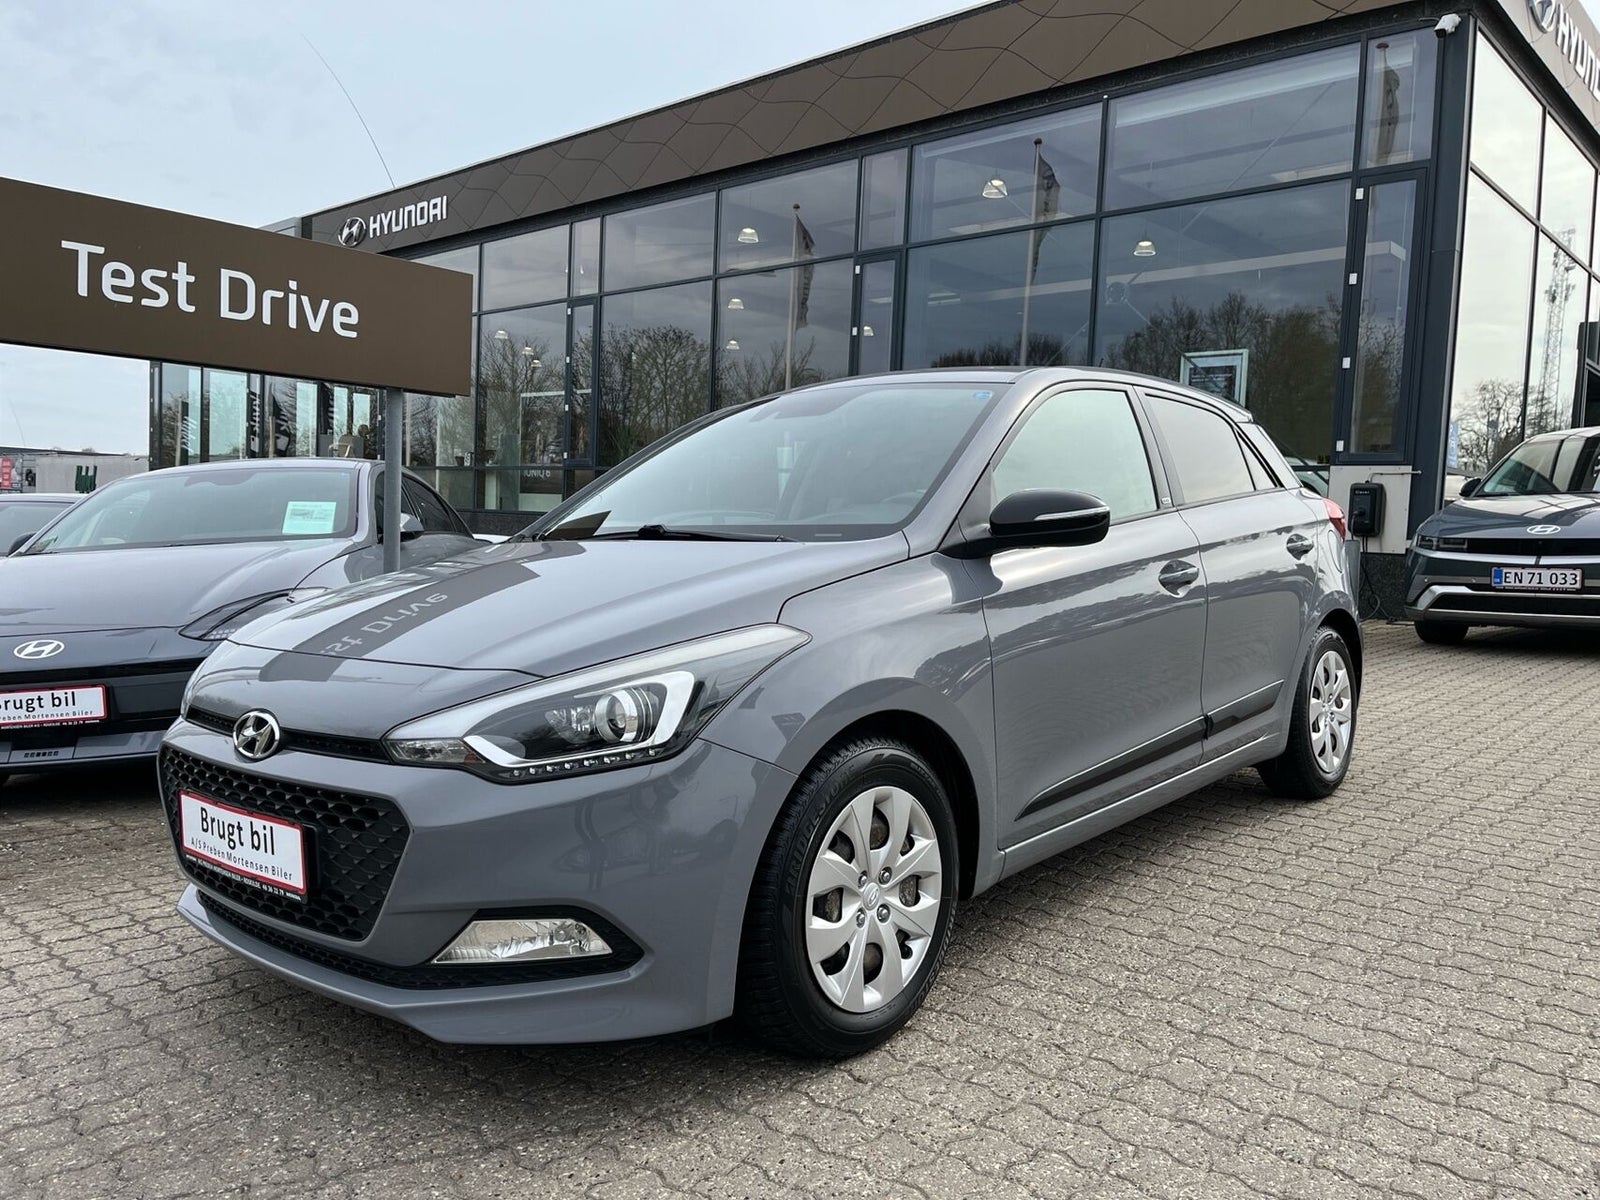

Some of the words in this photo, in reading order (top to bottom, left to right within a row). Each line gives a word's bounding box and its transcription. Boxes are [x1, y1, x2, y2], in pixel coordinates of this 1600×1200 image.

[369, 195, 448, 238] HYUNDAI
[60, 239, 196, 314] Test
[219, 267, 359, 339] Drive
[1503, 571, 1523, 584] EN
[1527, 572, 1544, 585] 71
[1549, 572, 1578, 586] 033
[24, 711, 70, 720] Mortensen
[51, 691, 76, 708] bil
[200, 806, 244, 850] Brugt
[250, 820, 275, 856] bil
[191, 837, 202, 849] A/S
[202, 842, 225, 860] Preben
[226, 851, 269, 874] Mortensen
[271, 865, 293, 881] Biler
